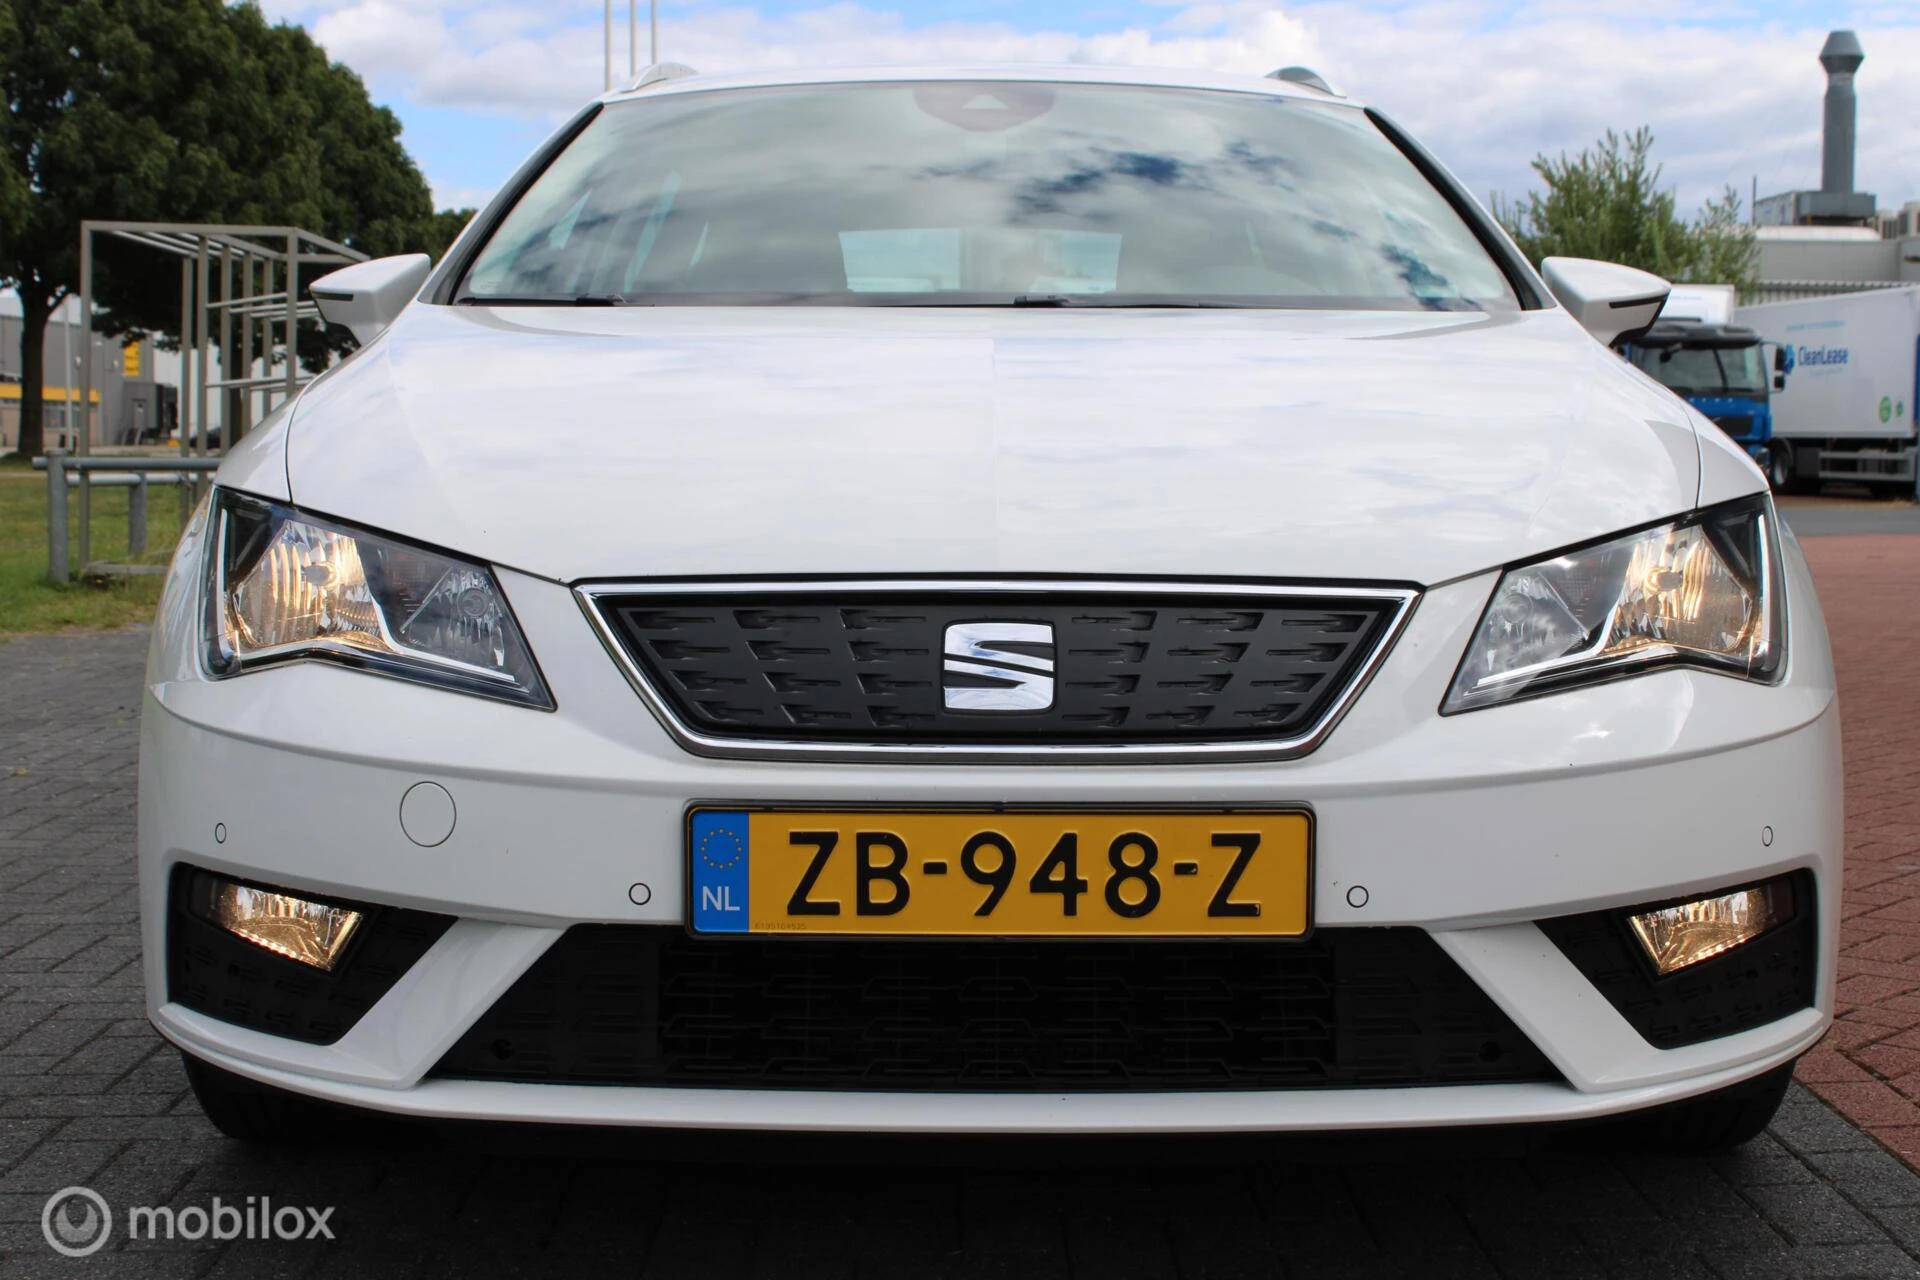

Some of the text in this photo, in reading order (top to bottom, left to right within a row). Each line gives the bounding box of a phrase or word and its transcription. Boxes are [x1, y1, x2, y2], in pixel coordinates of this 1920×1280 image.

[1798, 344, 1849, 367] CleanLease
[787, 830, 1261, 918] ZB-948-Z
[702, 886, 740, 911] NL
